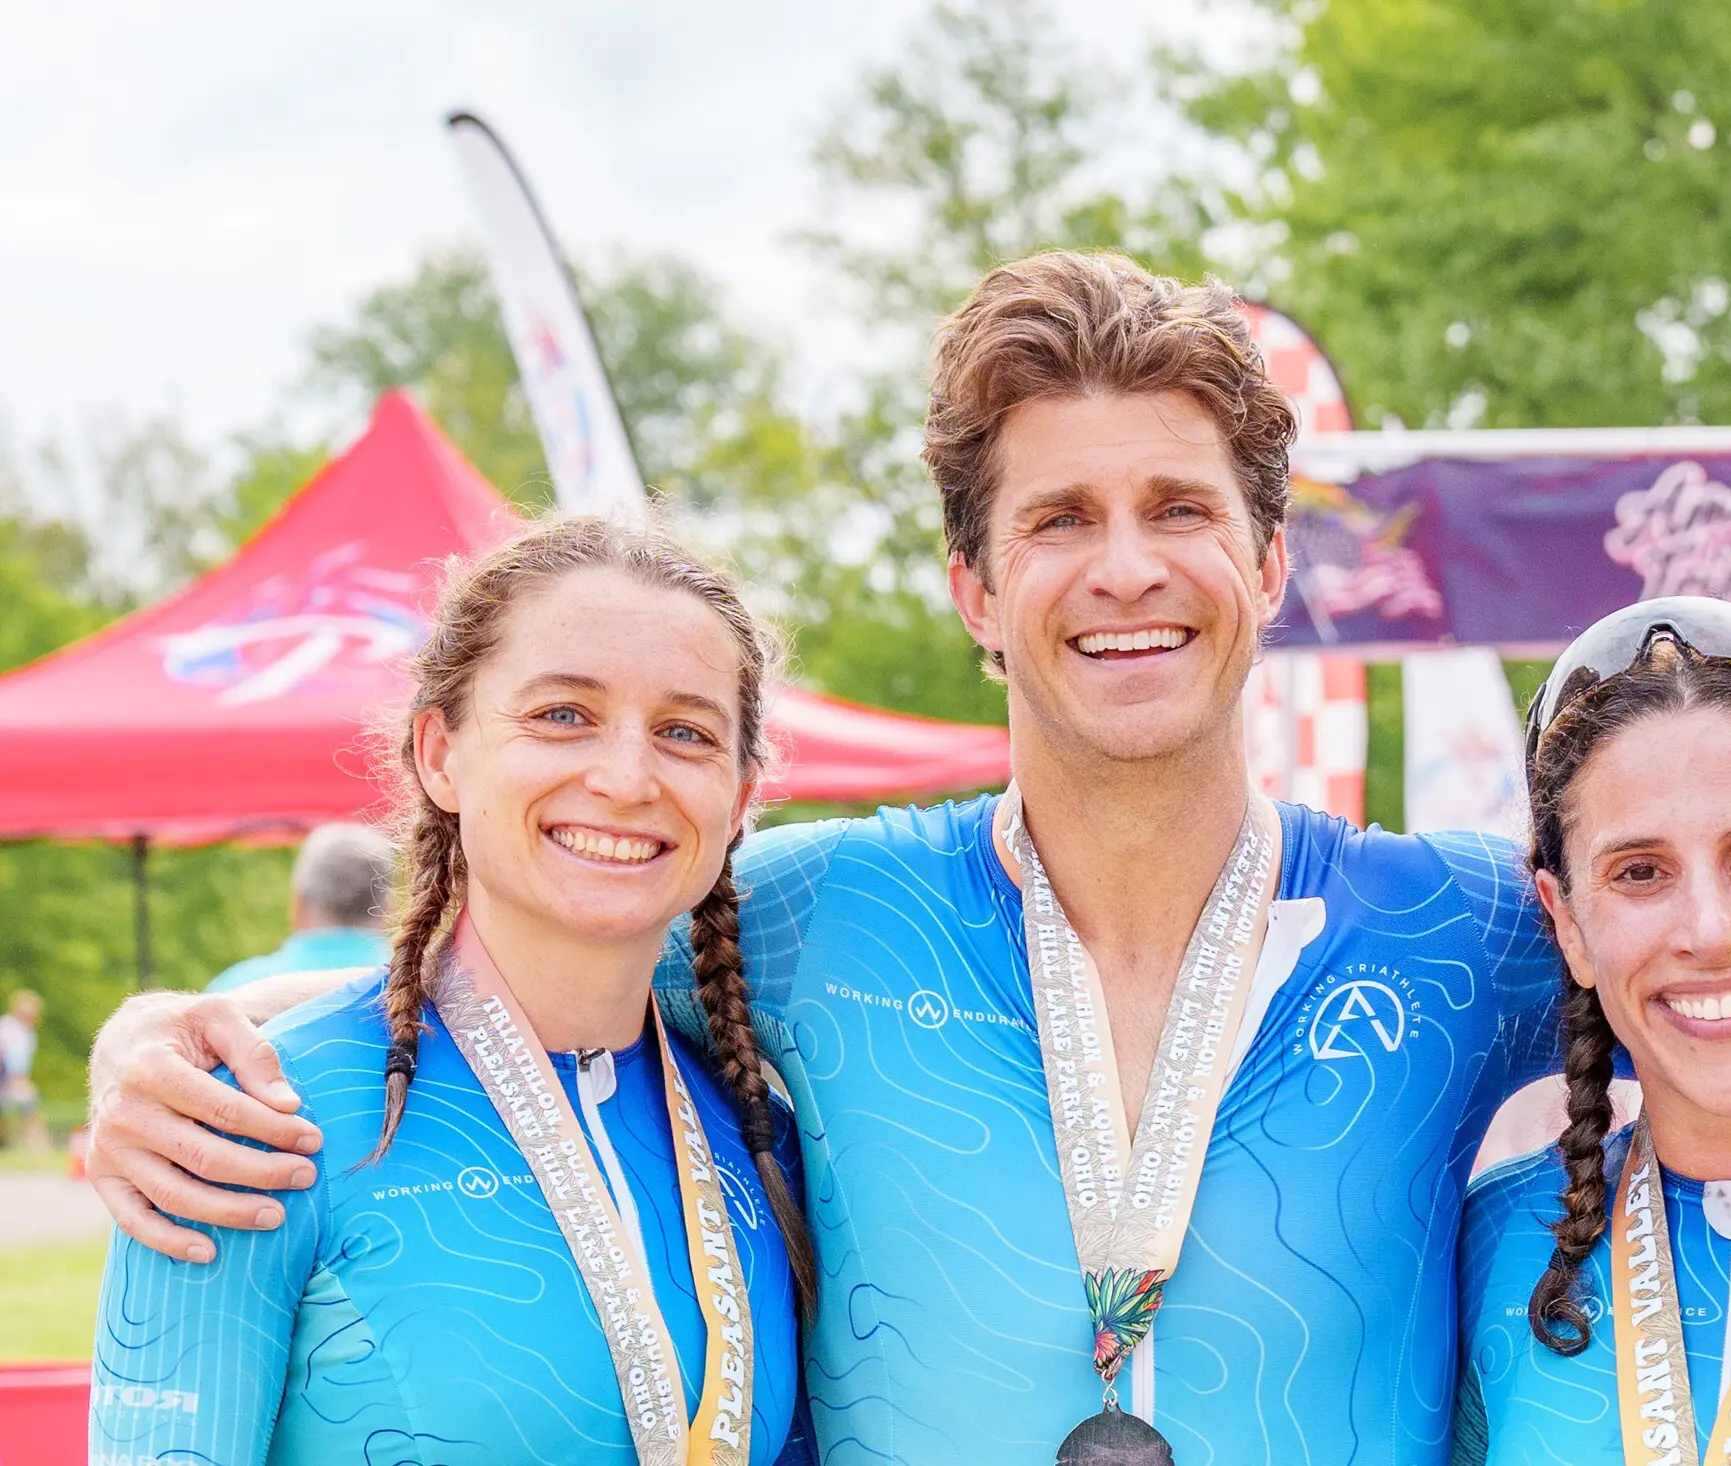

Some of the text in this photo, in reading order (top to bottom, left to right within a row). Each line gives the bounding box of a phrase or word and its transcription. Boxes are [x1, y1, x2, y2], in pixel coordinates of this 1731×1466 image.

[1037, 924, 1060, 979] HILL
[825, 982, 904, 1010] WORKING
[1046, 989, 1073, 1052] LAKE
[1134, 835, 1258, 1209] PLEASANT HILL LAKE PARK OHIO
[1293, 974, 1336, 1056] WORKING
[1346, 963, 1422, 1039] TRIATHLETE
[1056, 1060, 1086, 1129] PARK
[372, 1181, 454, 1201] WORKING
[713, 1151, 767, 1227] RIATHLETE
[1070, 1149, 1097, 1209] OHIO
[467, 1027, 545, 1138] PLEASANT
[534, 1144, 573, 1201] HILL
[564, 1207, 606, 1274] LAKE
[602, 1277, 635, 1351] PARK
[629, 1364, 657, 1431] OHIO
[1624, 1162, 1666, 1328] VALLEY
